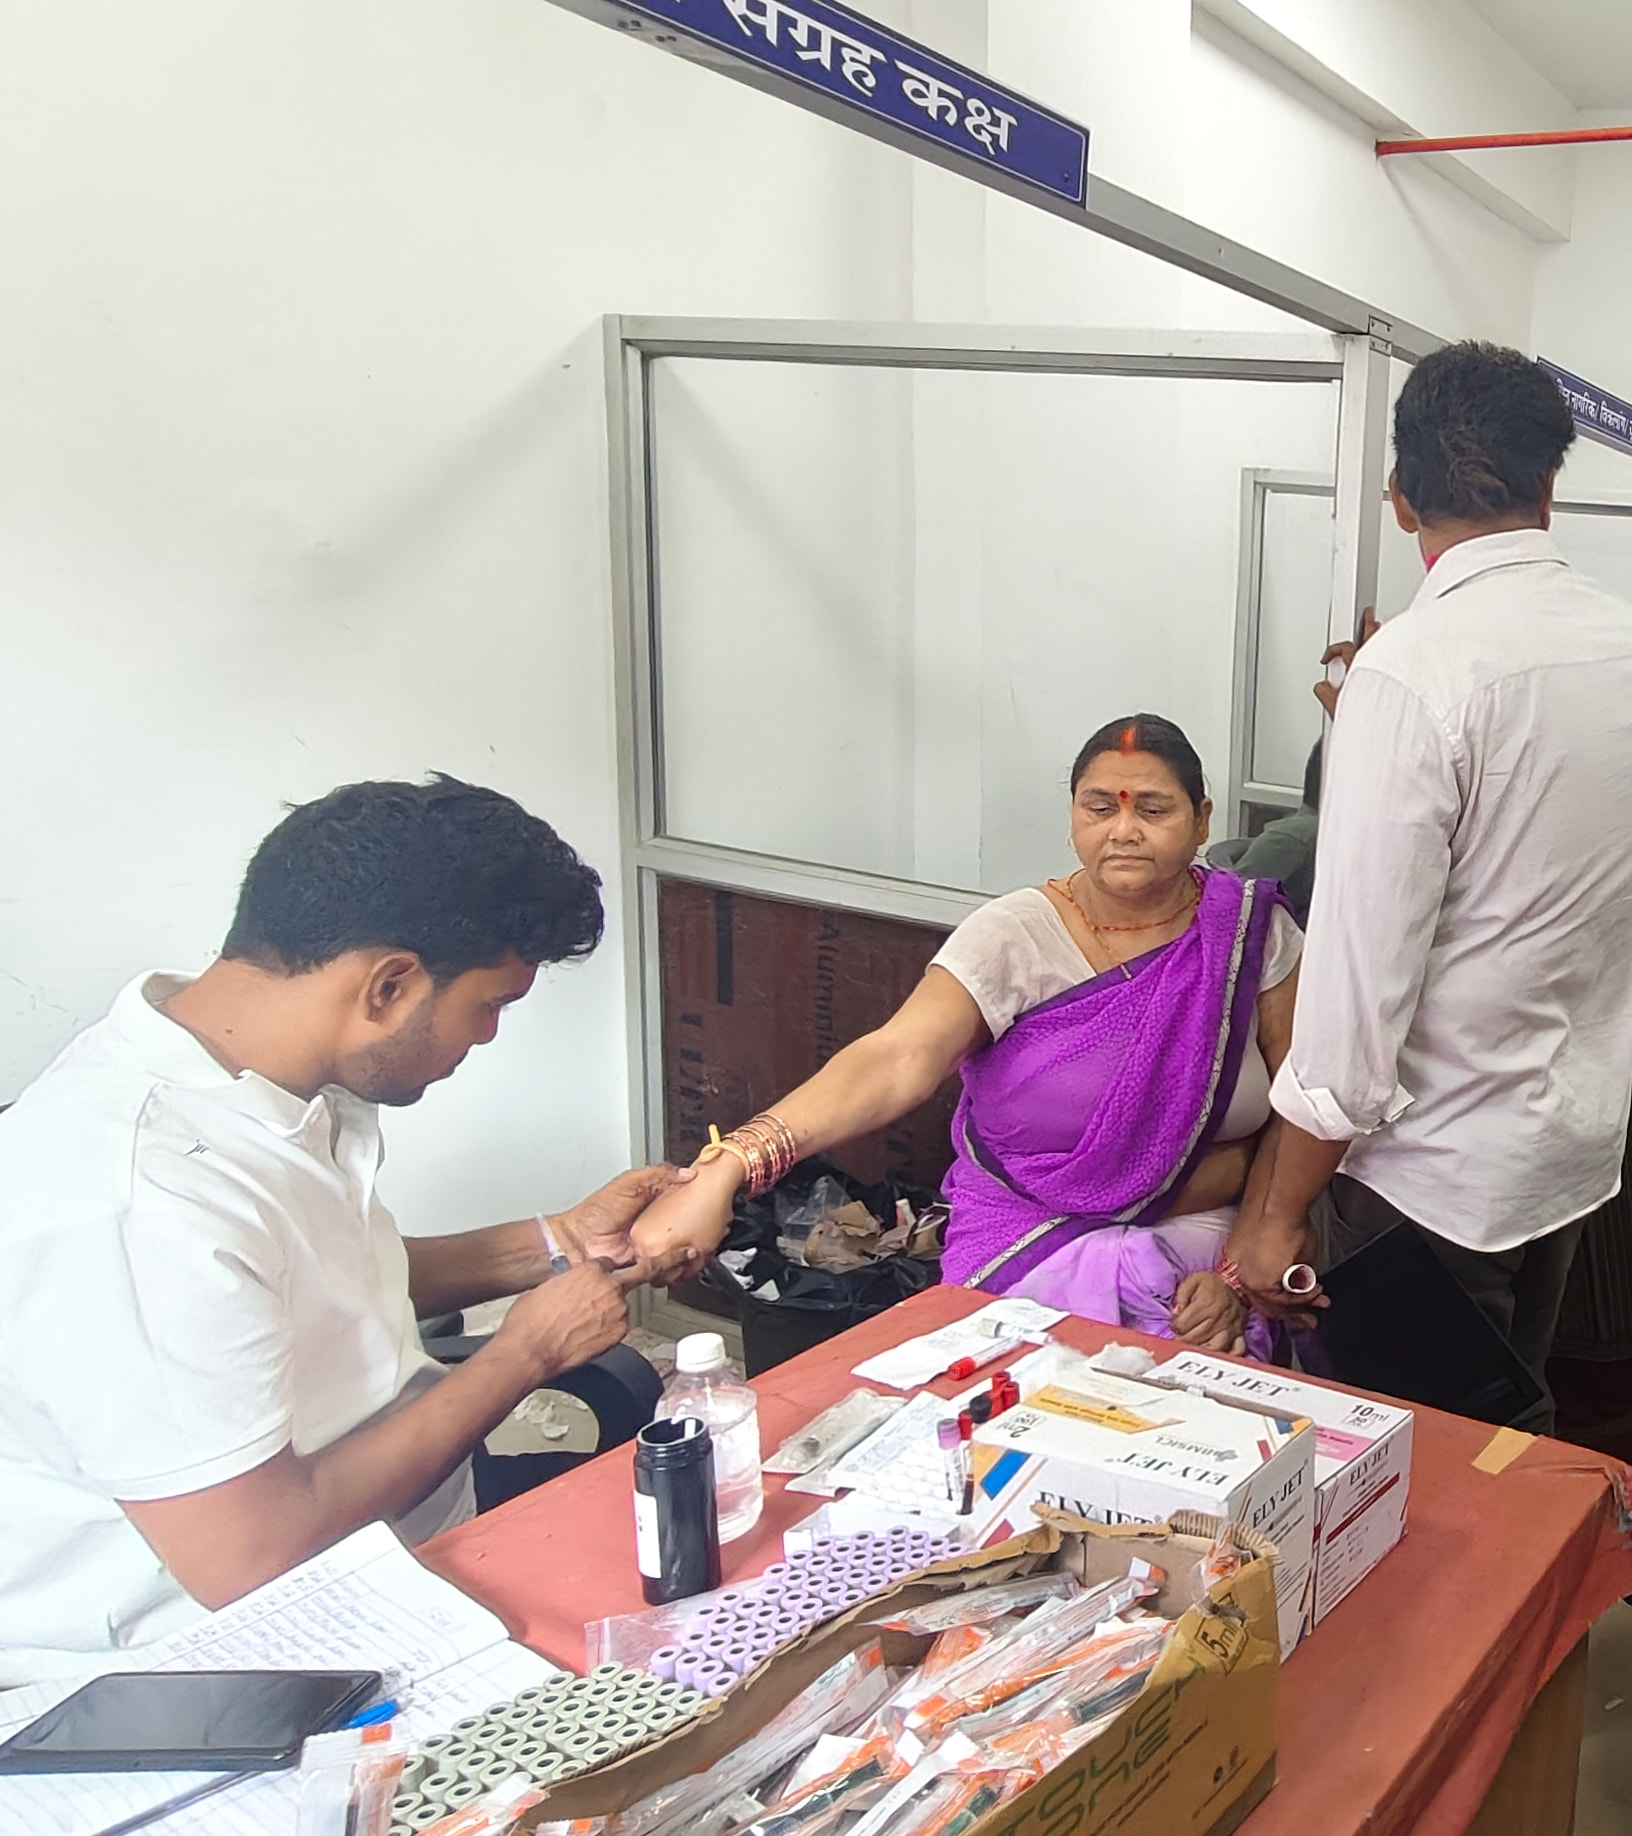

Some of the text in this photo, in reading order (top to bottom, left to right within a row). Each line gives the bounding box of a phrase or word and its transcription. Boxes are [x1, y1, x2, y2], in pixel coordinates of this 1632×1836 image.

[722, 0, 1018, 155] सग्रह कक्ष
[816, 922, 841, 1068] Aluminiu
[1176, 1360, 1292, 1397] ELY JET
[1350, 1403, 1390, 1422] 10ml
[1116, 1453, 1231, 1487] ELY JET
[1252, 1490, 1280, 1528] ELY
[1280, 1465, 1306, 1502] JET
